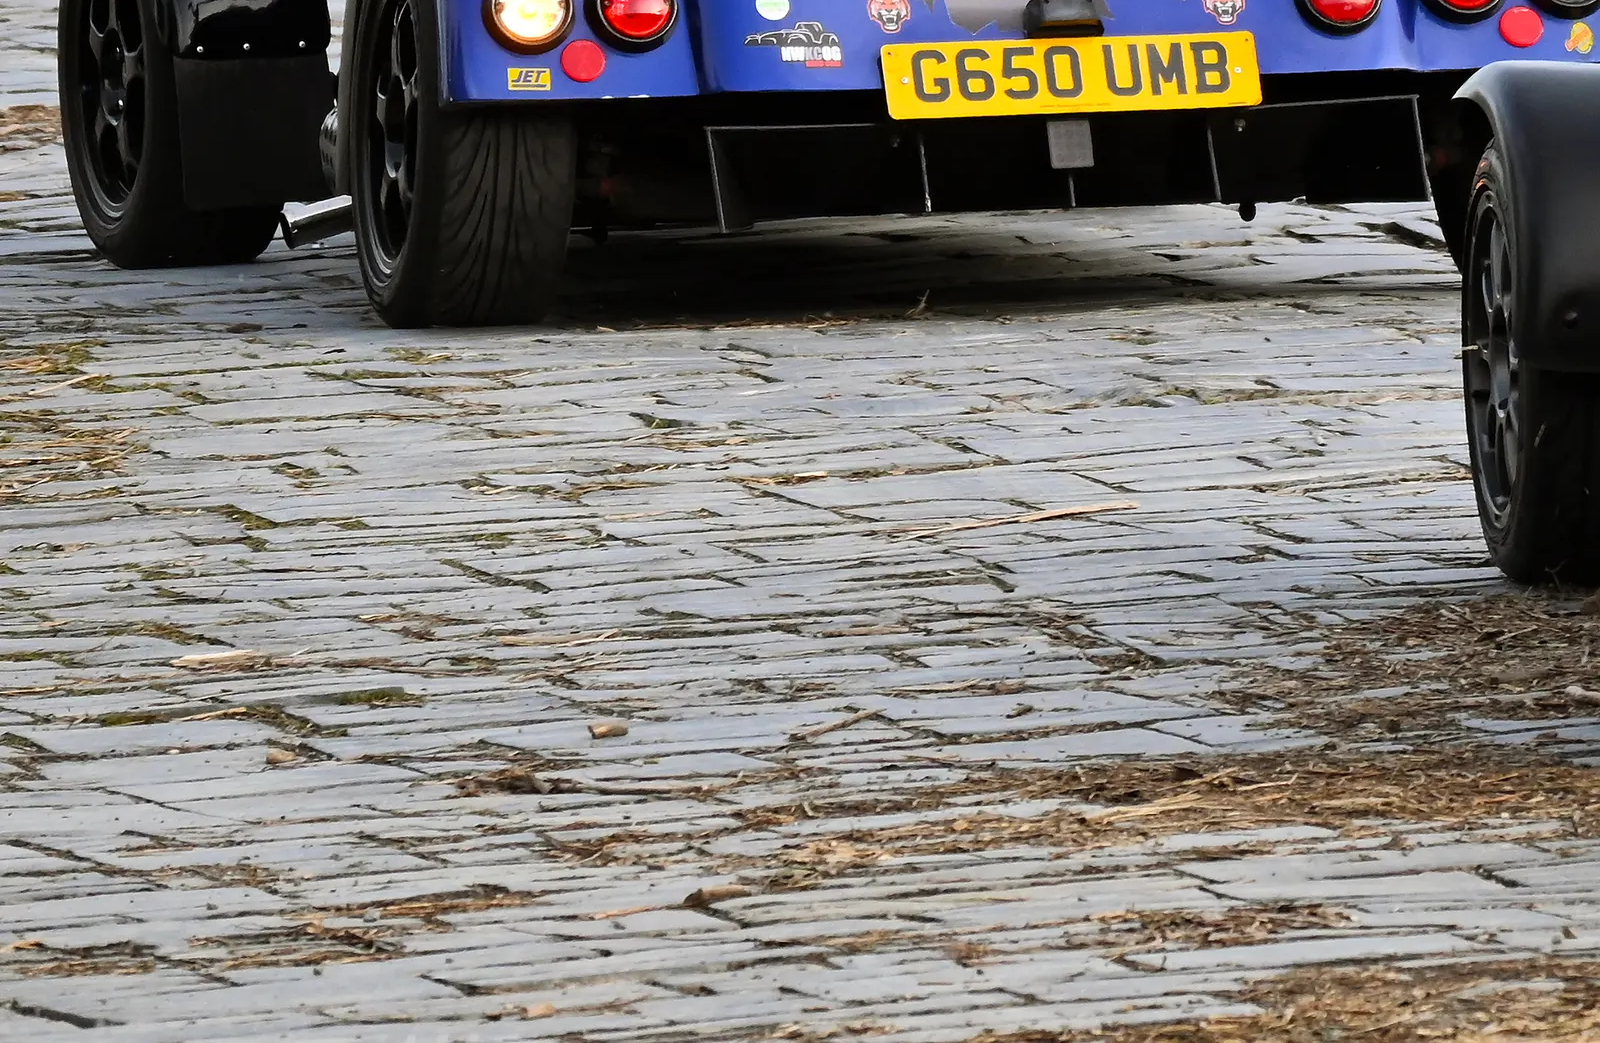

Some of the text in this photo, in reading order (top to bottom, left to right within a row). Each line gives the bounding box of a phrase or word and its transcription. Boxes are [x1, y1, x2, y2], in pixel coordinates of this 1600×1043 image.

[781, 45, 842, 61] NWKCOG
[511, 70, 547, 83] JET
[911, 41, 1231, 103] G650 UMB
